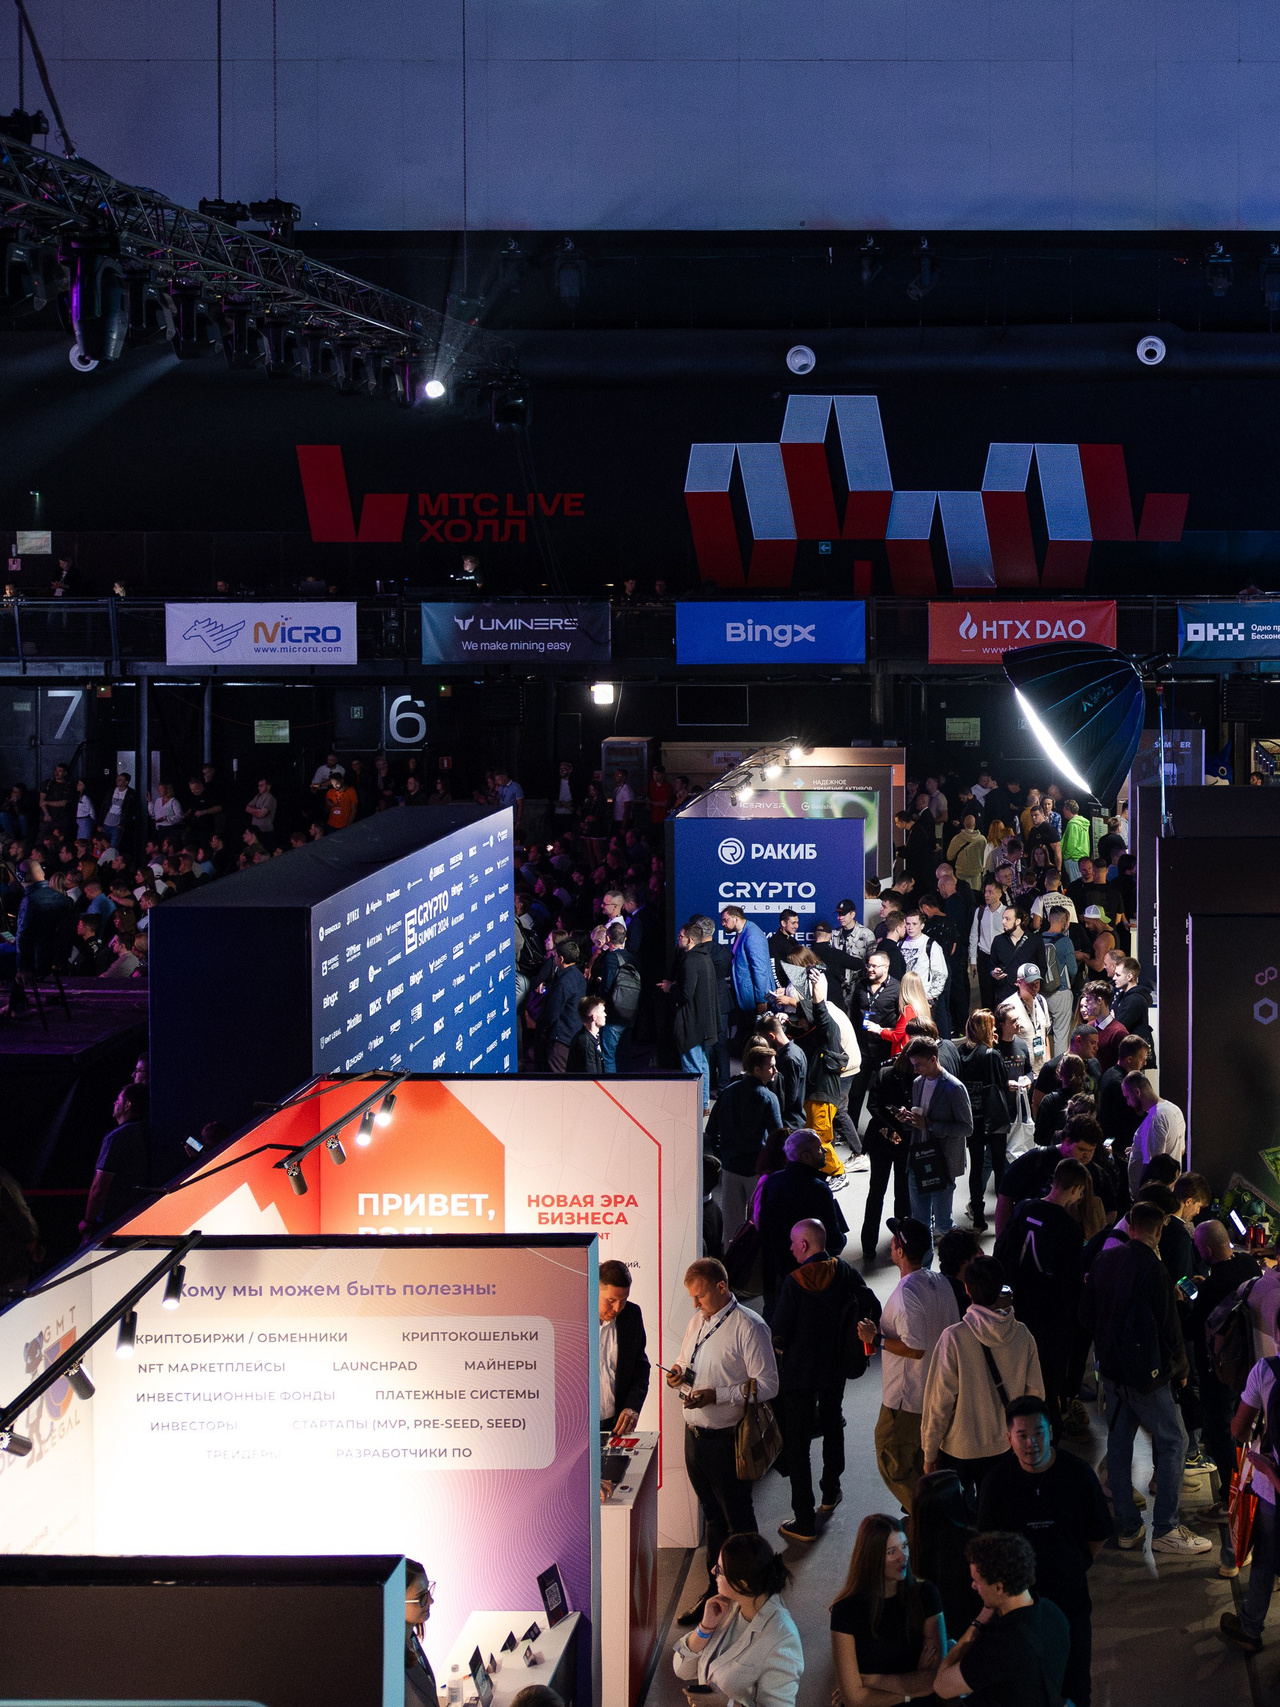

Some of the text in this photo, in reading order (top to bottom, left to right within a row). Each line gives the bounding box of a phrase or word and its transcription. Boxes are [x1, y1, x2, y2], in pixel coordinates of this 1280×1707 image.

[506, 493, 584, 516] LIVE
[419, 519, 526, 543] ХОЛЛ
[480, 618, 578, 631] UMINERS
[982, 620, 1086, 640] HTX DAO
[1251, 624, 1270, 632] Одно
[1187, 623, 1245, 641] OKX
[253, 645, 342, 655] www.microru.com
[461, 640, 571, 653] We make mining easy
[48, 690, 83, 739] 7
[388, 695, 427, 743] 6
[751, 843, 817, 860] РАКИБ
[718, 882, 816, 898] CRYPTO
[417, 890, 448, 927] CRYPTO
[418, 916, 449, 947] SUMMIT 2024
[357, 1193, 496, 1222] ПРИВЕТ,
[527, 1194, 639, 1208] НОВАЯ ЭРА
[537, 1211, 628, 1225] БИЗНЕСА
[233, 1284, 264, 1297] мы
[269, 1283, 340, 1297] можем
[346, 1281, 396, 1297] быть
[402, 1281, 498, 1297] полезны:
[43, 1305, 76, 1344] GMT
[135, 1331, 245, 1344] КРИПТОБИРЖИ
[257, 1331, 348, 1343] ОБМЕННИКИ
[402, 1330, 540, 1342] КРИПТОКОШЕЛЬКИ
[137, 1360, 286, 1374] NFT МАРКЕТПЛЕЙСЫ
[333, 1360, 418, 1372] LAUNCHPAD
[464, 1357, 538, 1371] МАЙНЕРЫ
[136, 1390, 335, 1404] ИНВЕСТИЦИОННЫЕ ФОНДЫ
[375, 1388, 540, 1401] ПЛАТЕЖНЫЕ СИСТЕМЫ
[150, 1420, 238, 1432] ИНВЕСТОРЫ
[292, 1417, 527, 1432] СТАРТАПЫ (MVP, PRE-SEED, SEED)
[205, 1446, 281, 1460] ТРЕЙДЕРЫ
[336, 1447, 472, 1460] РАЗРАБОТЧИКИ ПО
